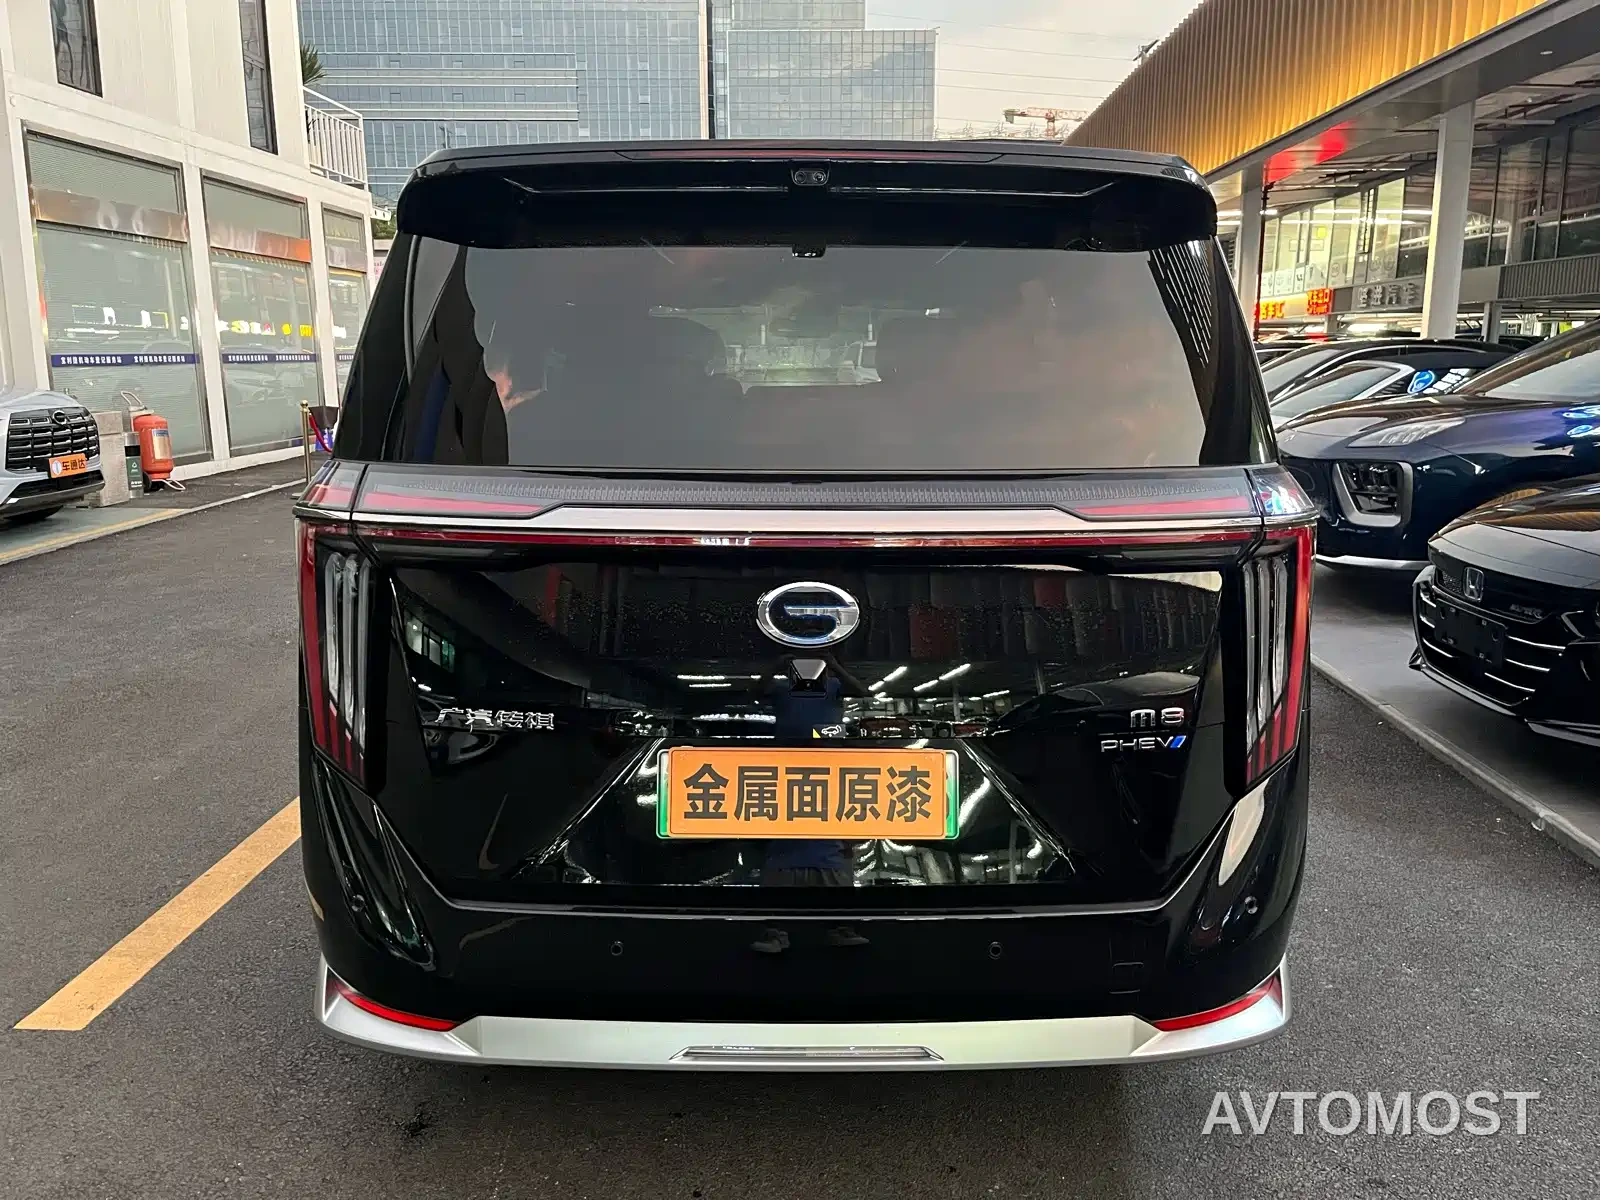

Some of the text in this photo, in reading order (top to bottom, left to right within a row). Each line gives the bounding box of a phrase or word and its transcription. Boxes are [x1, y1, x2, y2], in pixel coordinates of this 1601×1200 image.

[62, 459, 86, 472] 车通达
[435, 707, 554, 731] 广汽传祺
[1130, 707, 1185, 728] M8
[1101, 736, 1175, 752] PHEV
[683, 763, 932, 822] 金属面原漆
